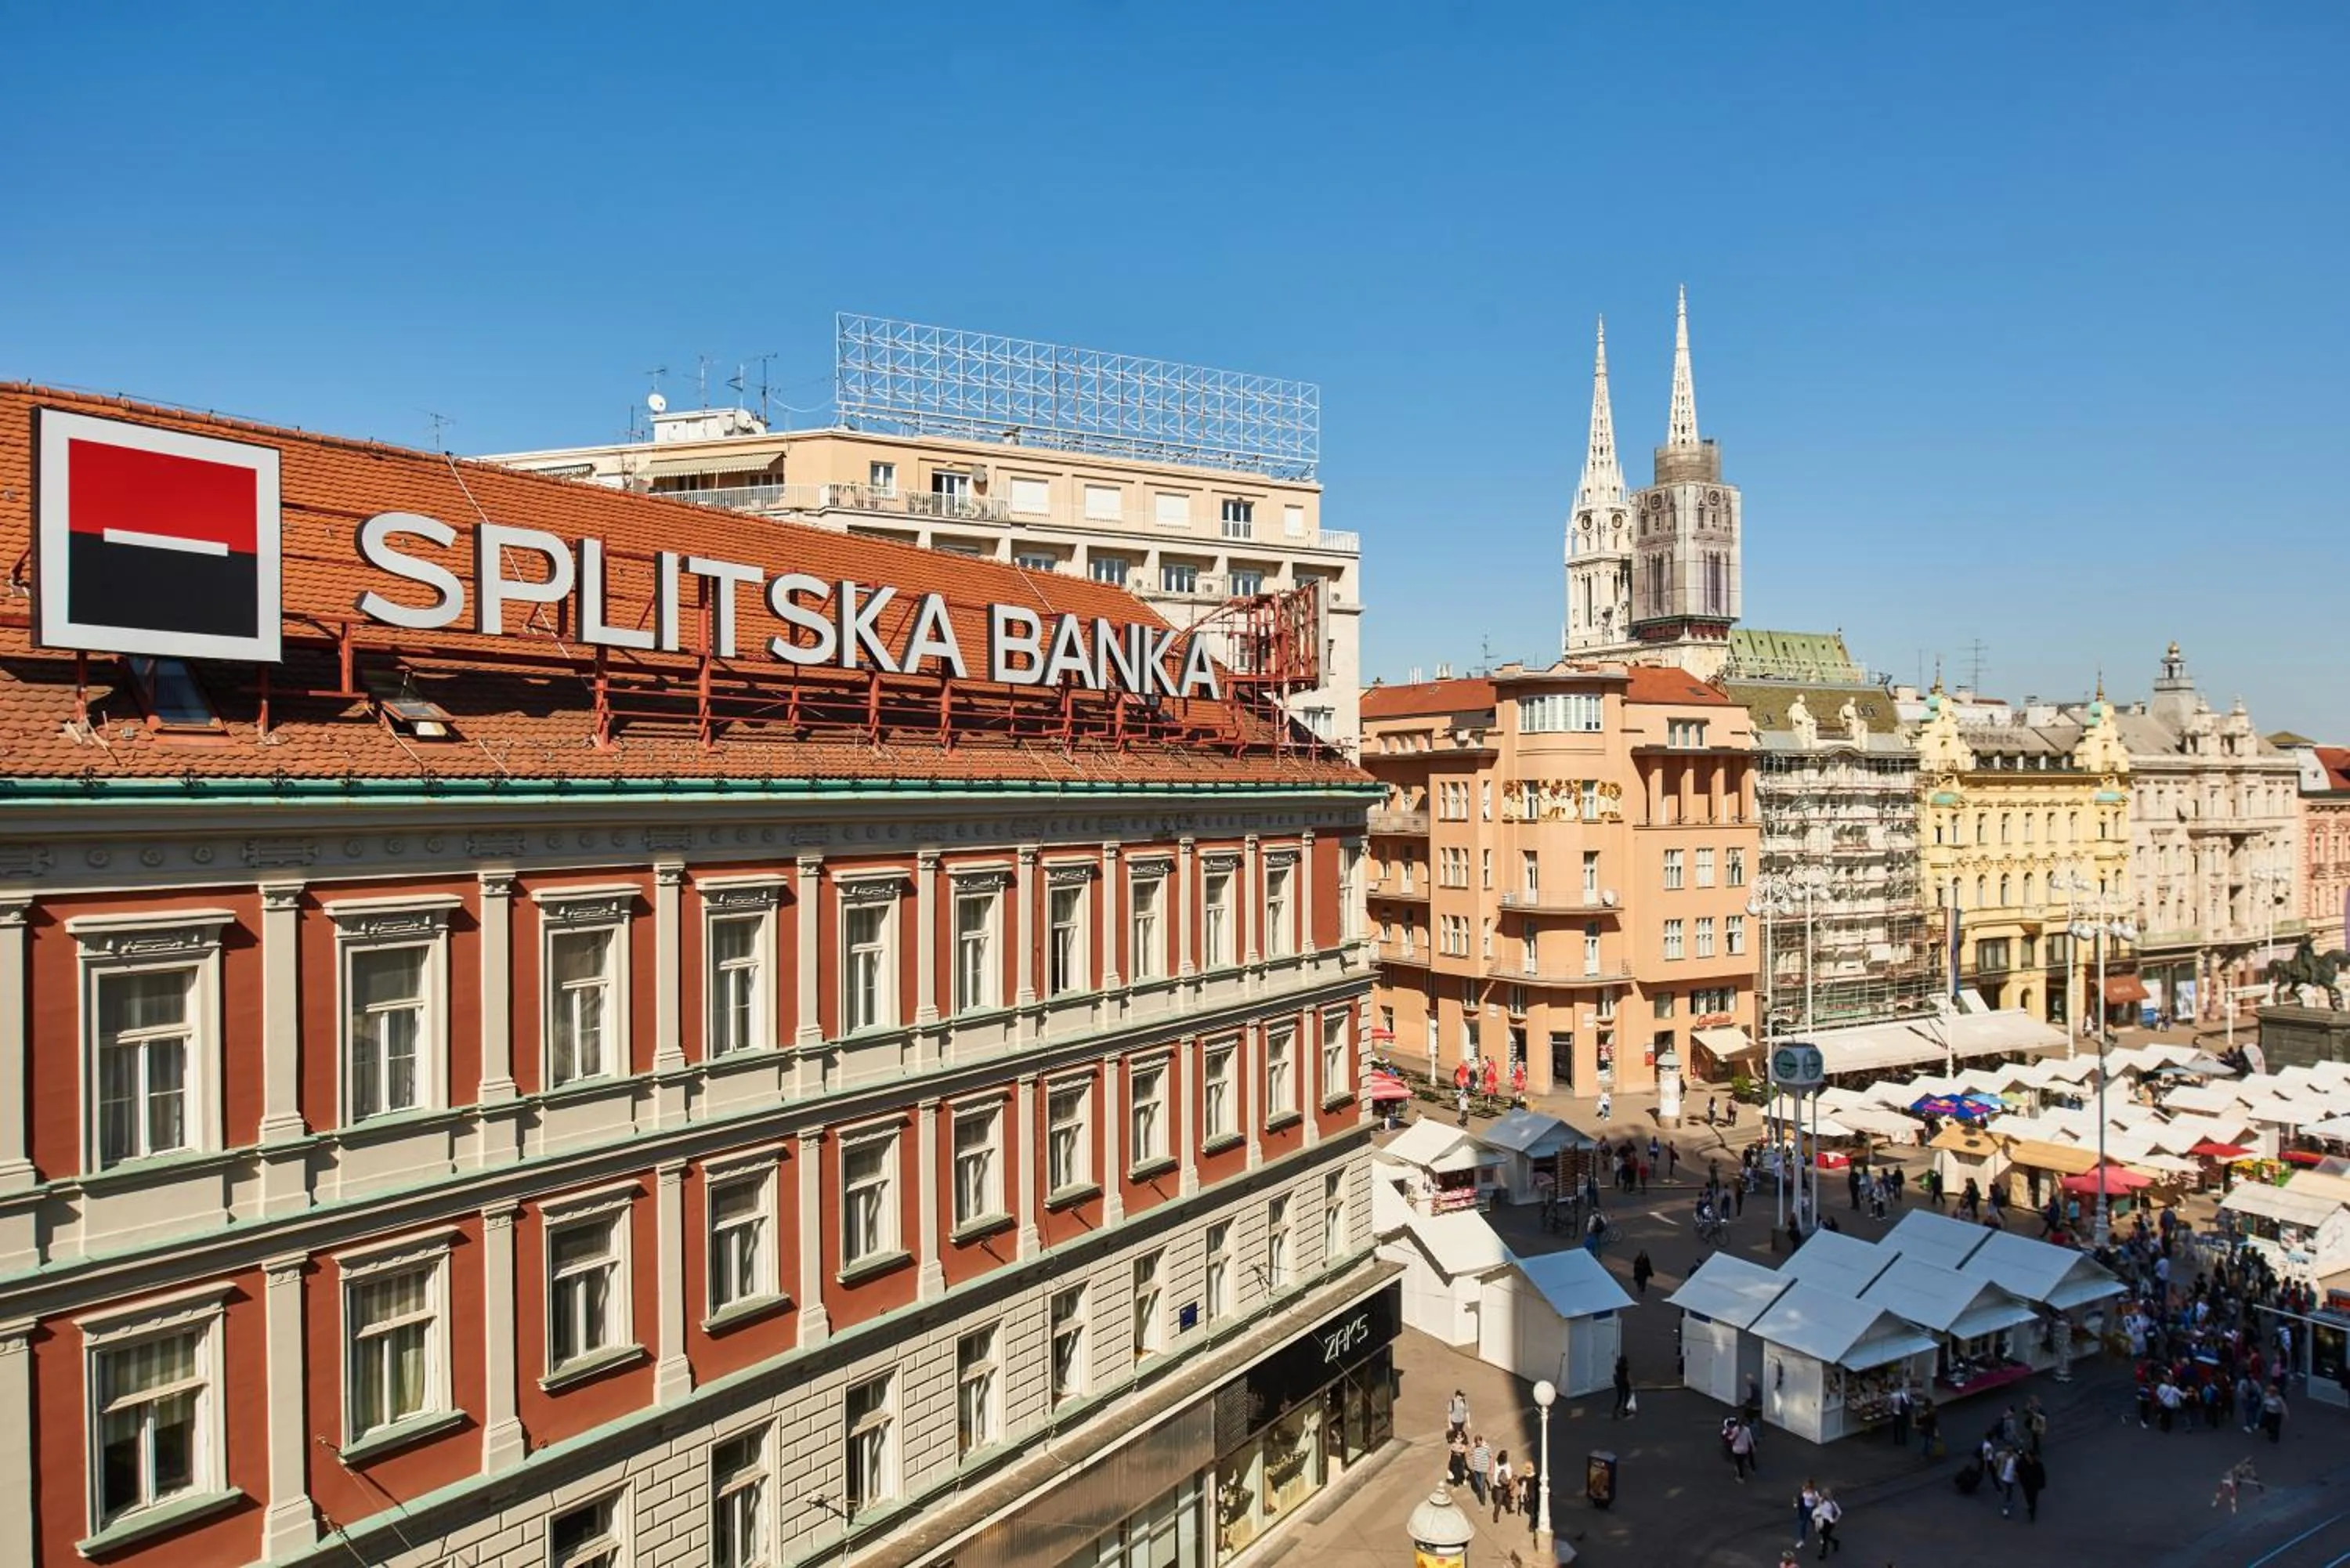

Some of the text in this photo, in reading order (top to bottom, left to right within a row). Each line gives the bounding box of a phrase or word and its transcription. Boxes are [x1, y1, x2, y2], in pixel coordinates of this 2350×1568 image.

[358, 511, 1220, 700] SPLITSKA BANKA
[1325, 1313, 1368, 1364] ZAKS
